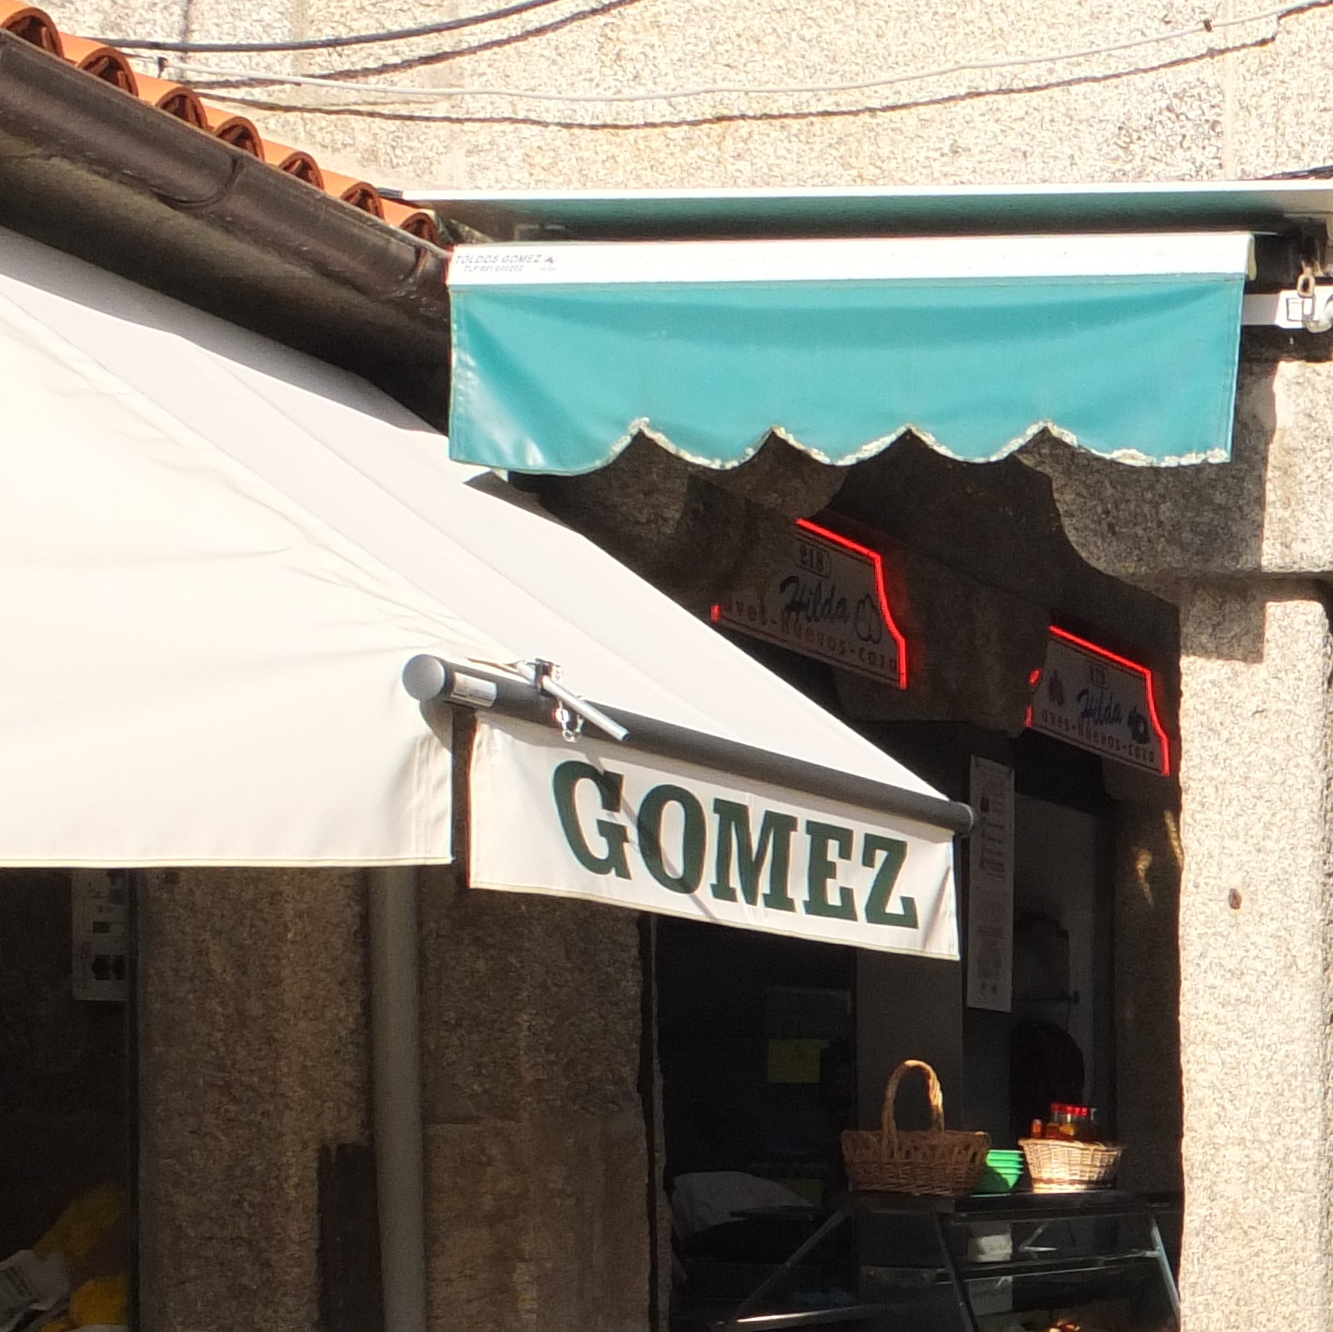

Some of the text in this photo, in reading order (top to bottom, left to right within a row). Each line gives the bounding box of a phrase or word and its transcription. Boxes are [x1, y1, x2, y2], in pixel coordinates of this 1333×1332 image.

[456, 255, 499, 264] TOLDOS
[779, 575, 850, 624] Hilda
[552, 759, 919, 929] GOMEZ
